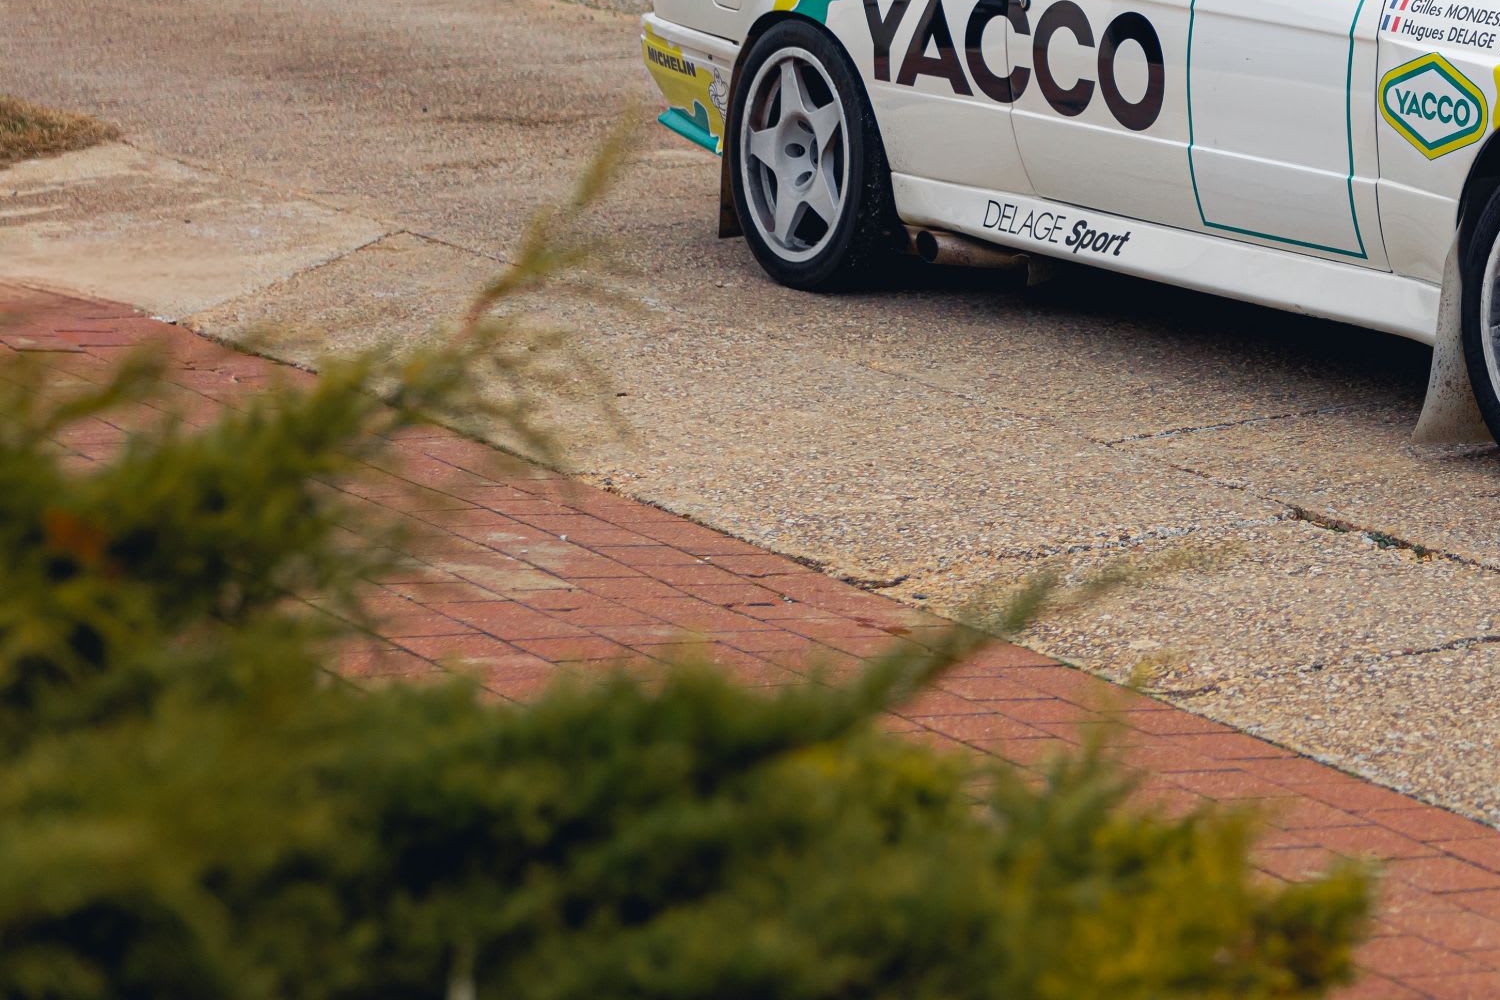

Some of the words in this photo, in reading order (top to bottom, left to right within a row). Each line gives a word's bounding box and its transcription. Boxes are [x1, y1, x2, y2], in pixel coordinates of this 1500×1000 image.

[1401, 18, 1445, 42] Hugues
[1447, 26, 1496, 49] DELAGE
[647, 46, 697, 78] MICHELIN
[1395, 87, 1470, 127] YACCO
[983, 199, 1067, 244] DELAGE
[1065, 219, 1131, 256] Sport
